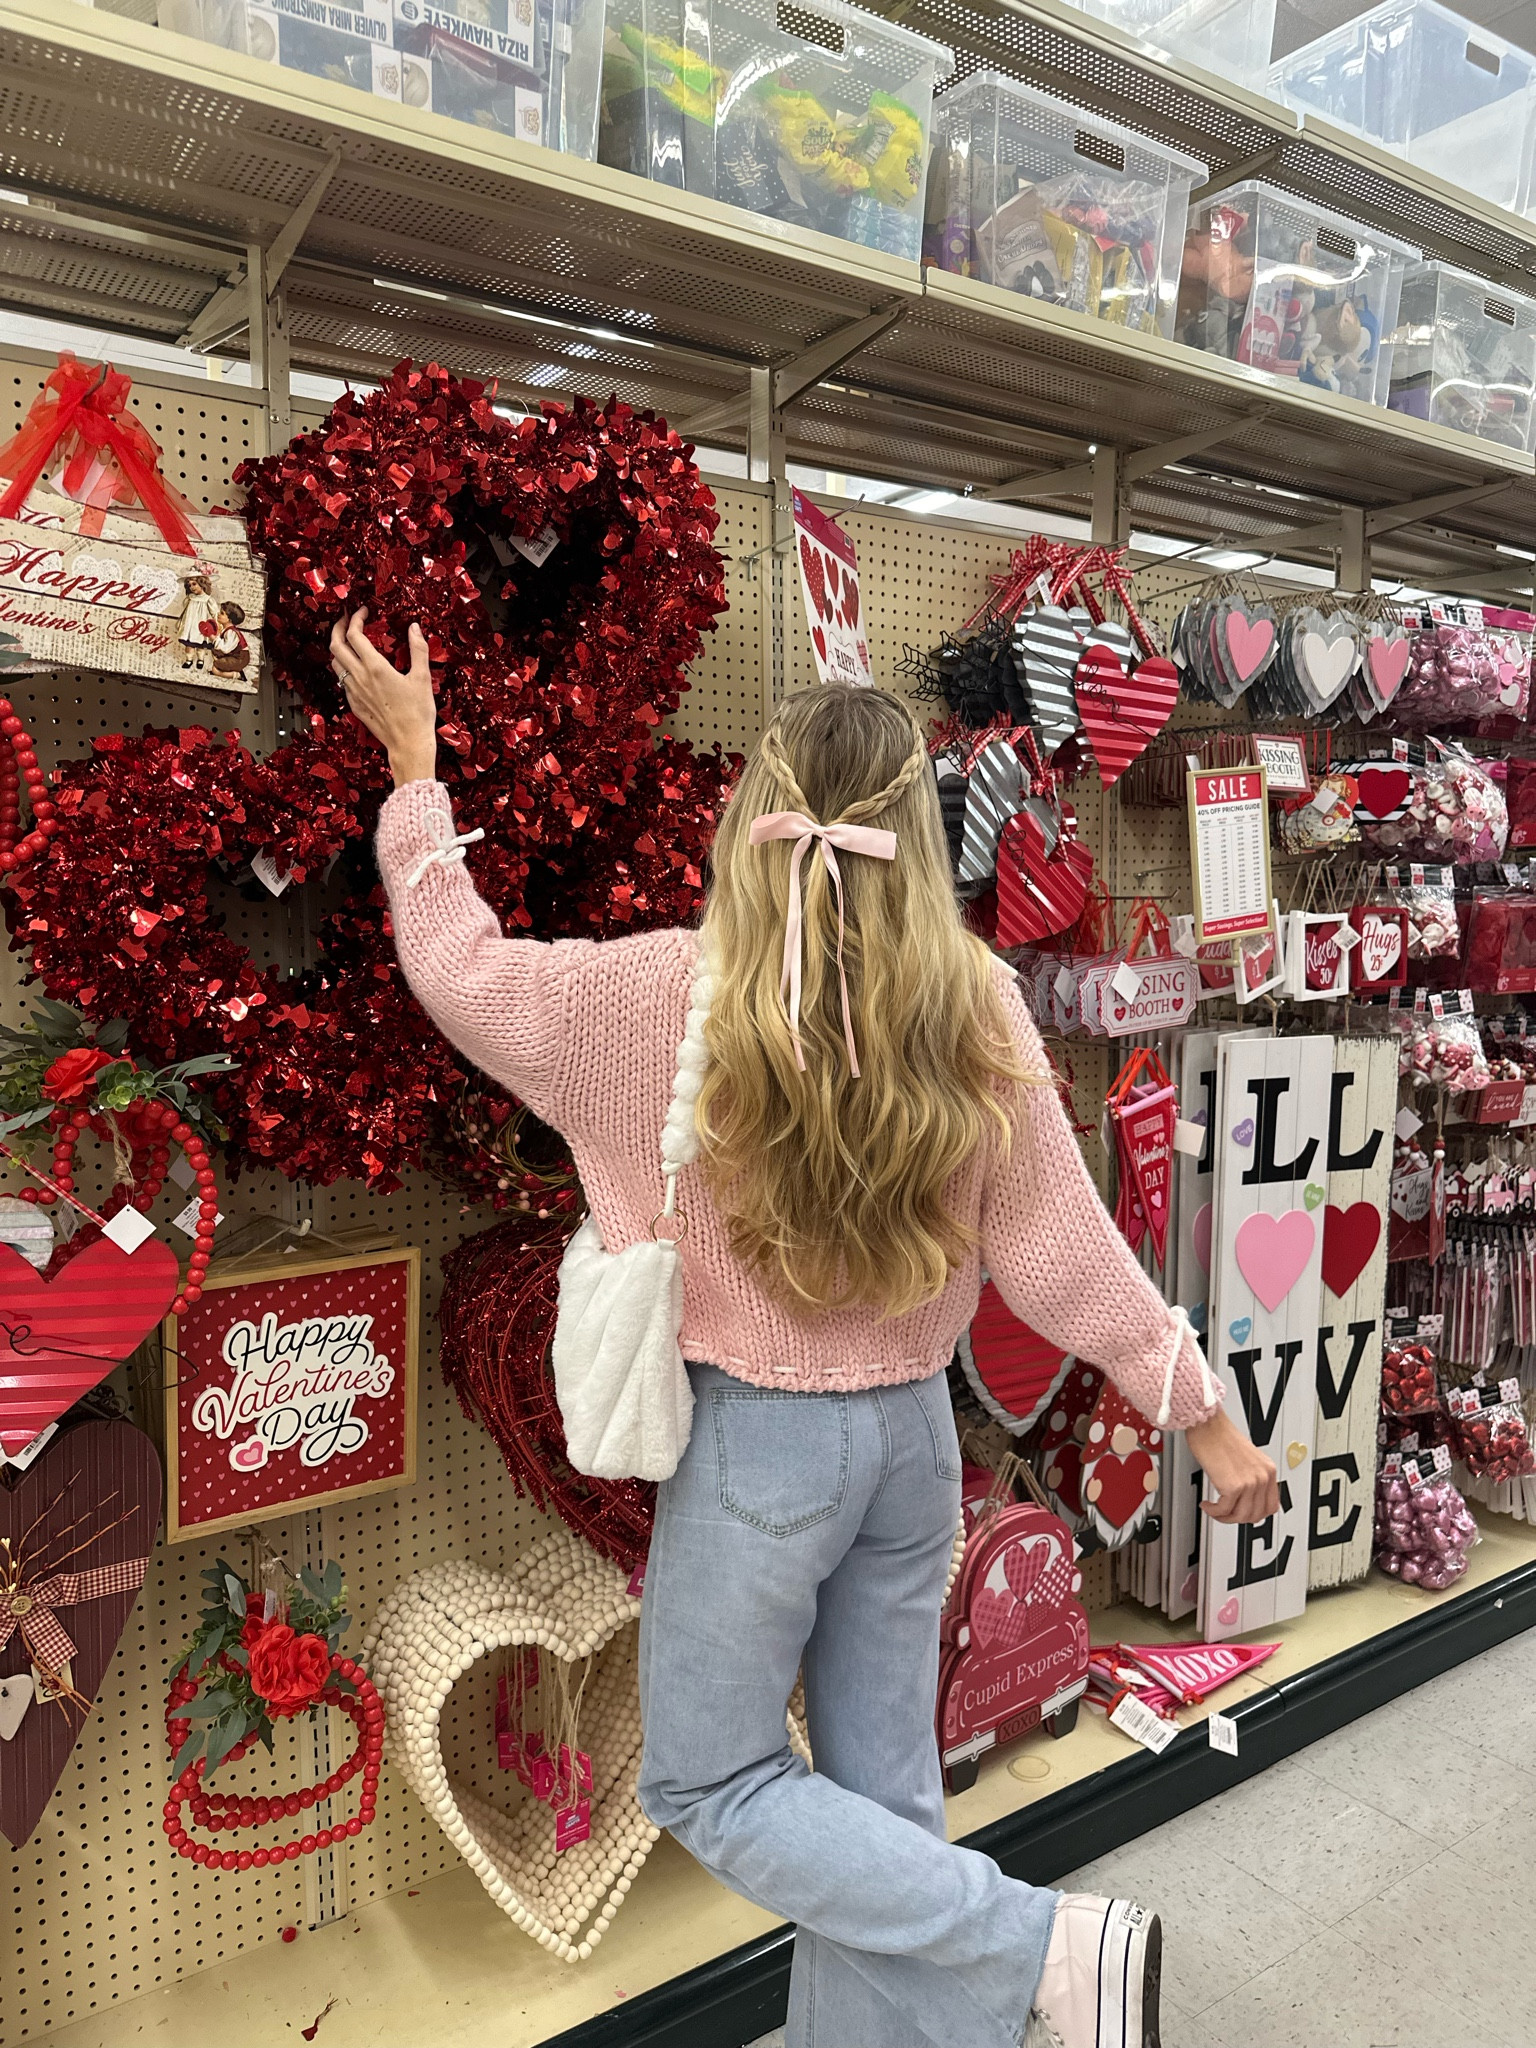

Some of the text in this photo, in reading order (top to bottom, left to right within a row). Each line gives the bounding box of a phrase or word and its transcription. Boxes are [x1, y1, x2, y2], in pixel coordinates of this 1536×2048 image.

[328, 7, 353, 32] MIRA
[354, 13, 387, 41] OLIVIER
[423, 7, 529, 62] RIZA HAWKEYE
[0, 540, 166, 611] Happy
[106, 615, 173, 654] Day
[834, 647, 857, 677] HAPPY
[1259, 747, 1300, 765] KISSING
[1266, 763, 1297, 776] BOOTH
[1208, 776, 1249, 802] SALE
[1197, 802, 1260, 816] 40% OFF PRICING GUIDE
[1204, 924, 1217, 933] Super
[1233, 919, 1245, 928] Super
[1362, 920, 1399, 954] Hugs
[1305, 935, 1339, 974] Kisses
[1129, 998, 1170, 1020] BOOTH
[1235, 1123, 1253, 1141] LOVE
[1241, 1077, 1320, 1185] L
[1133, 1142, 1170, 1172] Valentine's
[1144, 1166, 1165, 1190] DAY
[228, 1318, 370, 1372] Happy
[199, 1359, 391, 1434] Valentine's
[262, 1397, 364, 1462] Day
[963, 1643, 1075, 1711] Cupid Express
[1148, 1649, 1239, 1690] XOXO
[1002, 1710, 1038, 1740] XOXO
